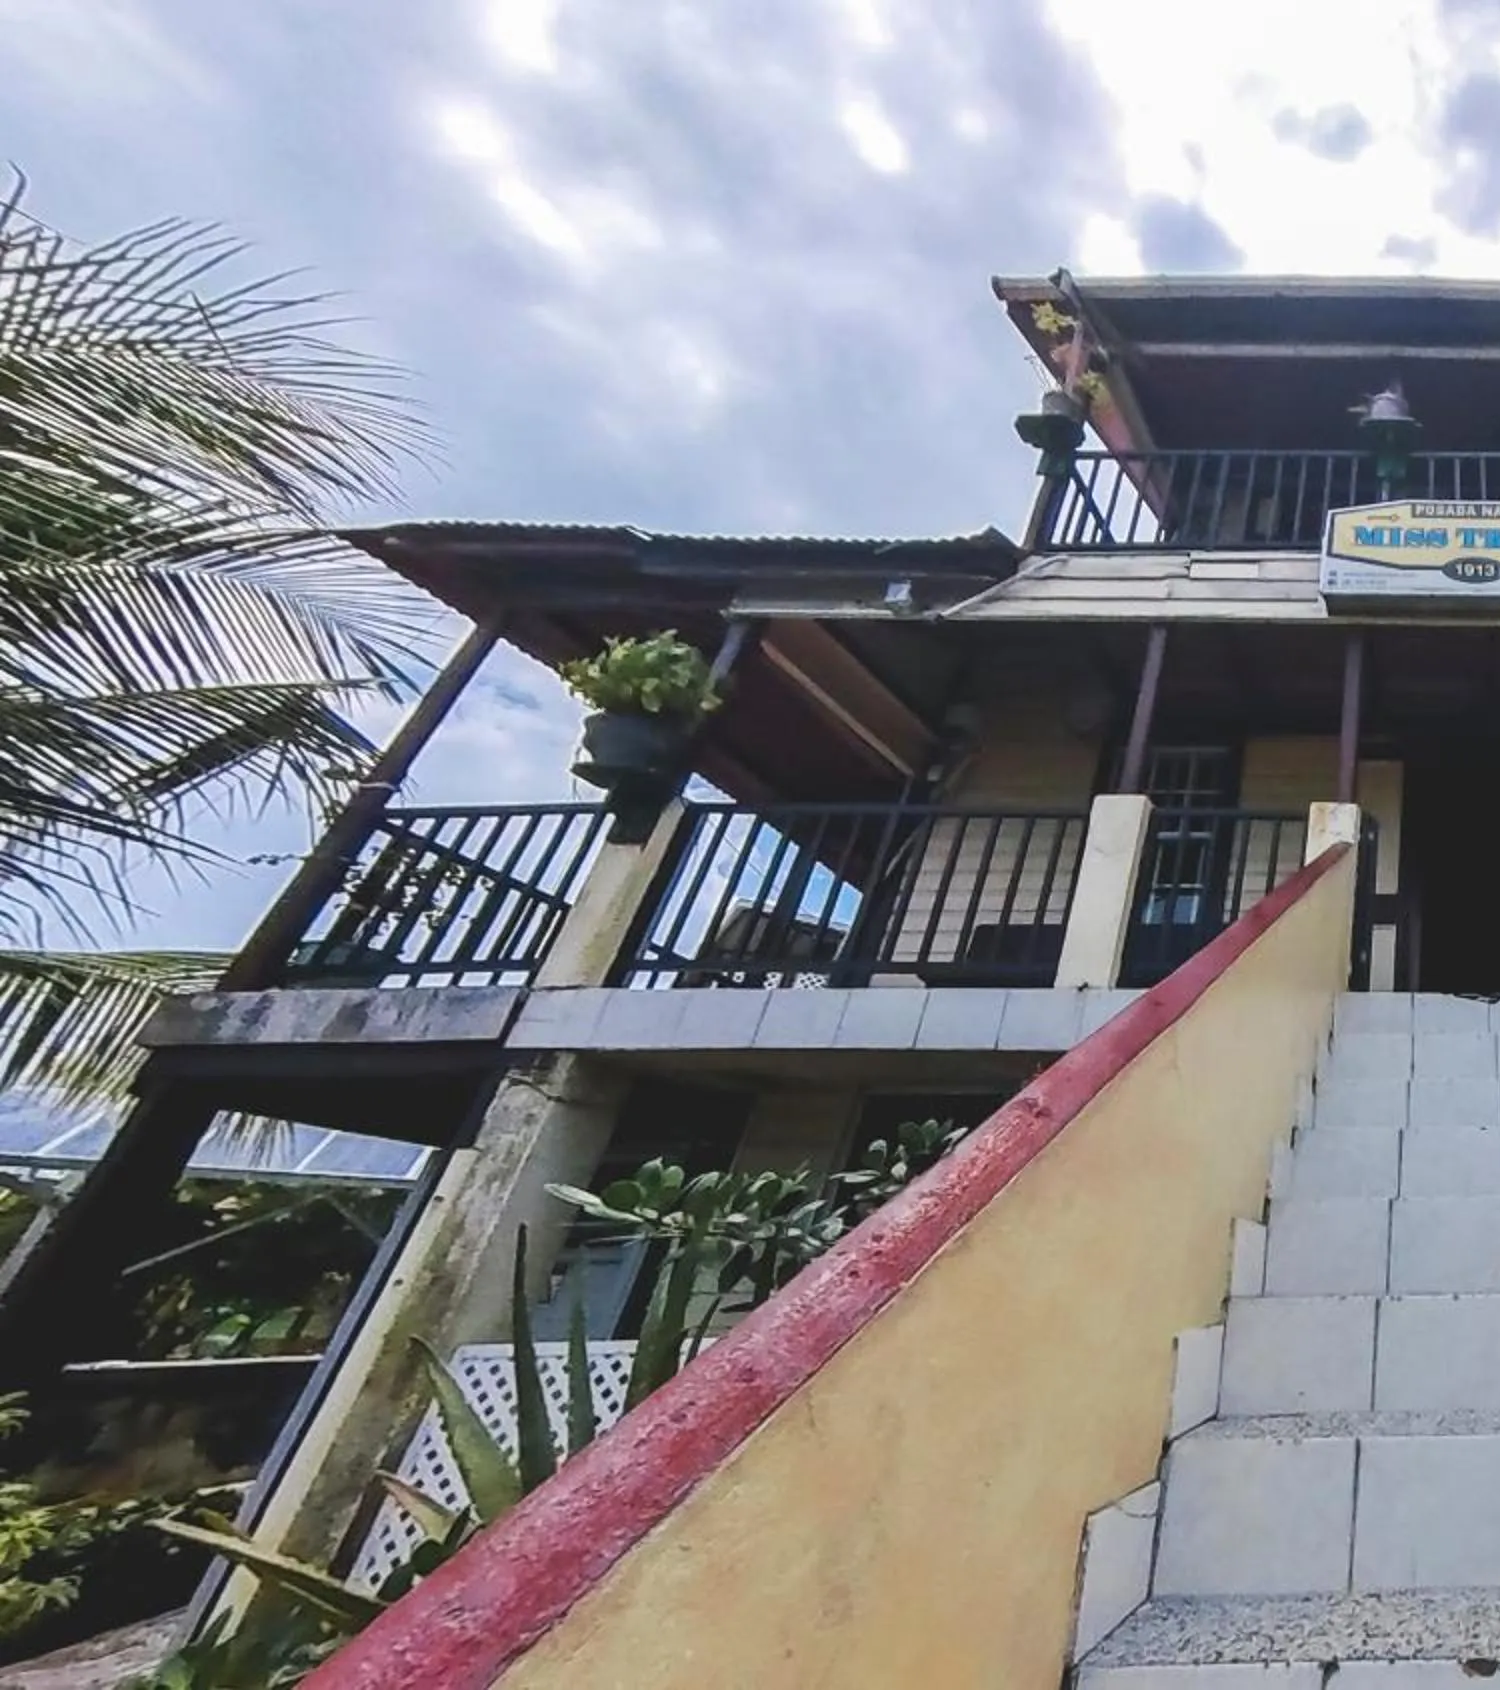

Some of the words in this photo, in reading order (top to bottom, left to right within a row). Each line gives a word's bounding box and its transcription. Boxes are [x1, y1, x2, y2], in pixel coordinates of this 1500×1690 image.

[1415, 504, 1476, 517] POSADA
[1354, 526, 1448, 547] MISS
[1455, 563, 1496, 577] 1913
